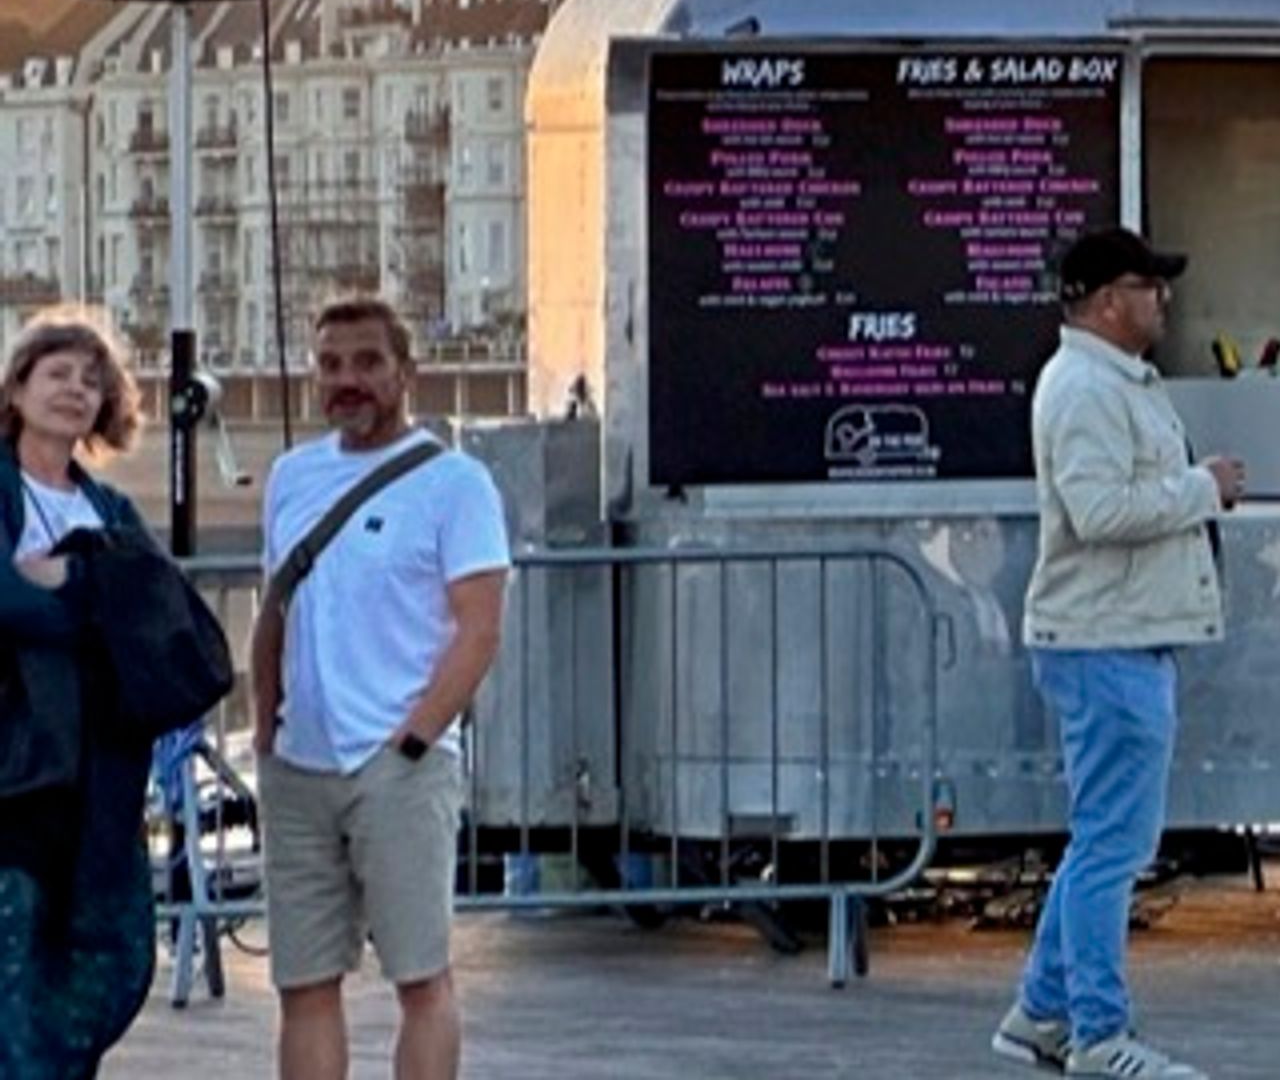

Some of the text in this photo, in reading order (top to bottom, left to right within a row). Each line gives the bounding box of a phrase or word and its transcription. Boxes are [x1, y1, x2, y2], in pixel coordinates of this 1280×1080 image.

[721, 58, 805, 86] WRAPS
[897, 56, 1118, 84] FRIES & SALAD BOX
[849, 313, 917, 341] FRIES
